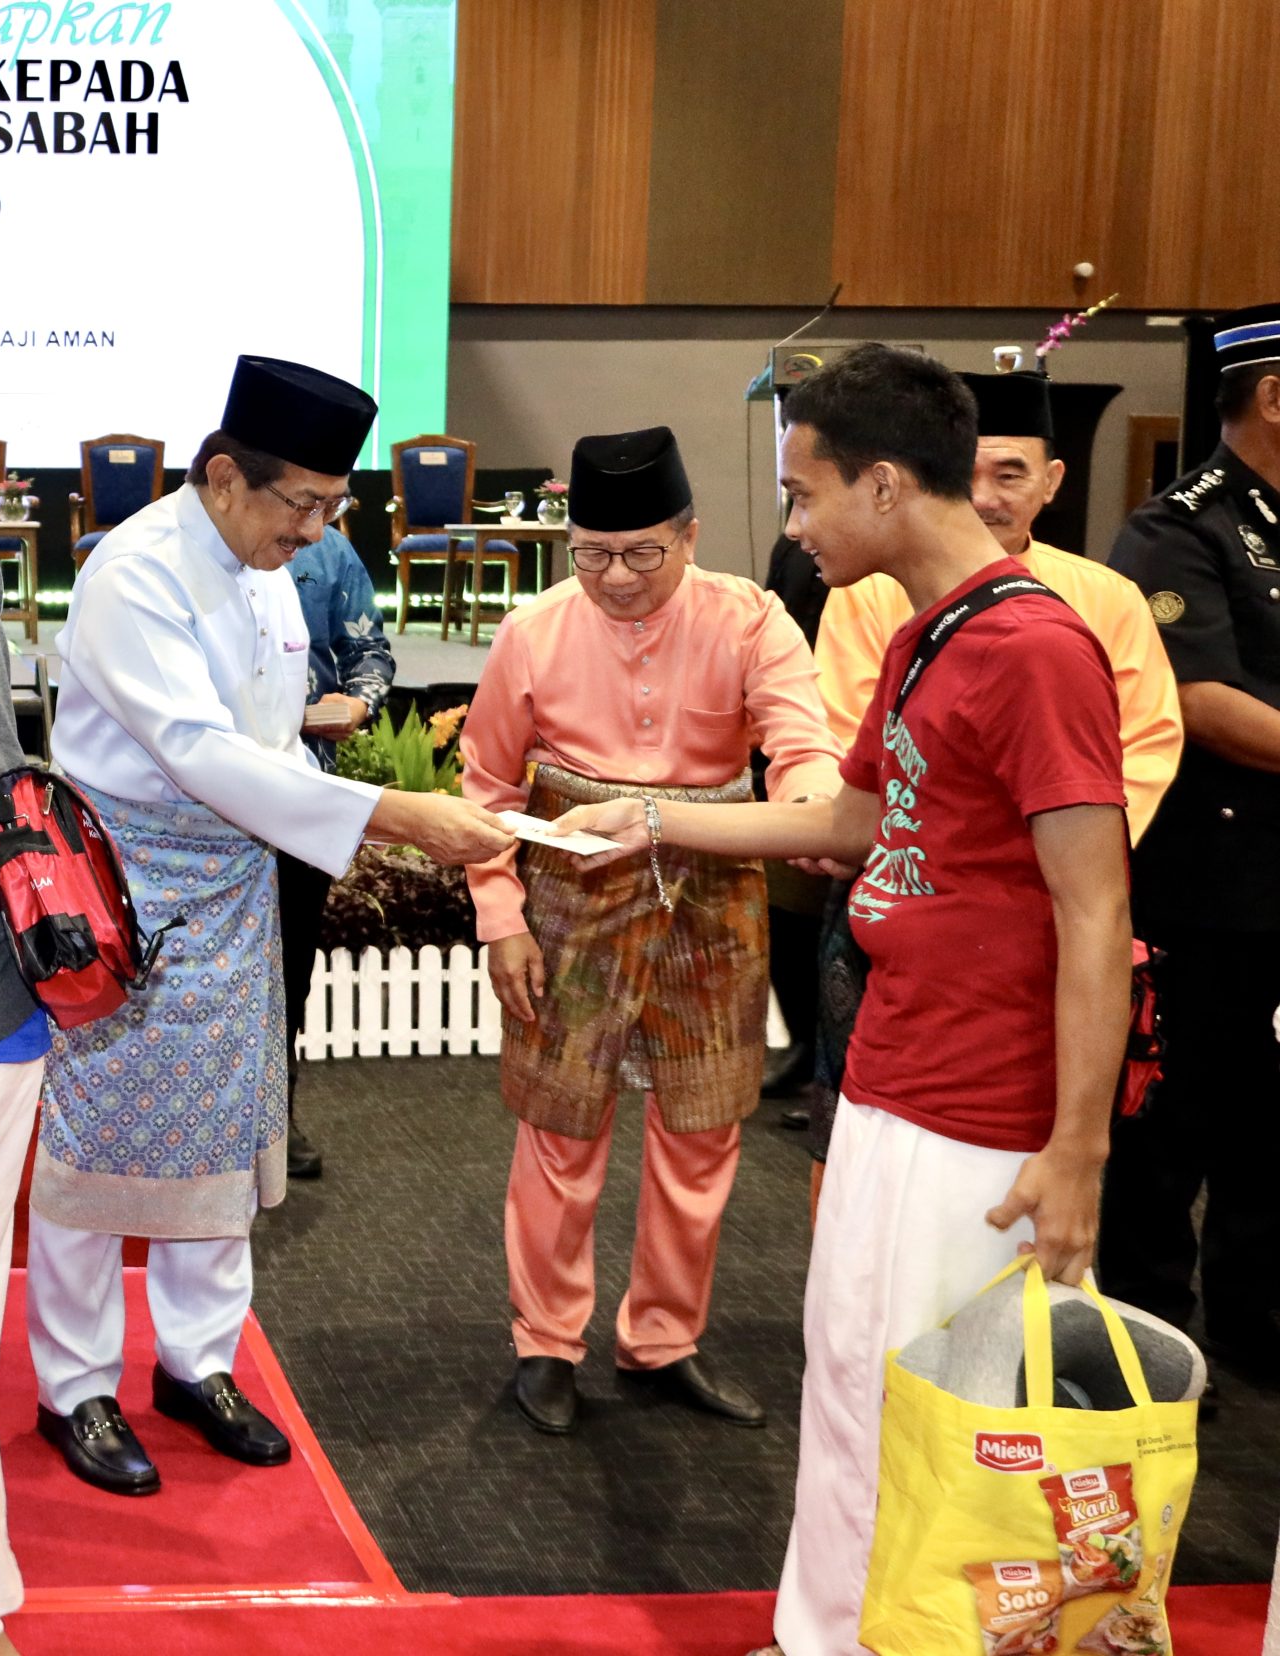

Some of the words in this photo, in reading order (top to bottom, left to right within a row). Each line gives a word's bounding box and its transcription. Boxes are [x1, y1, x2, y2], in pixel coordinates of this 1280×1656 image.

[46, 331, 115, 347] AMAN
[981, 1440, 1039, 1459] Mieku
[1070, 1493, 1117, 1522] Kari
[997, 1590, 1049, 1614] Soto
